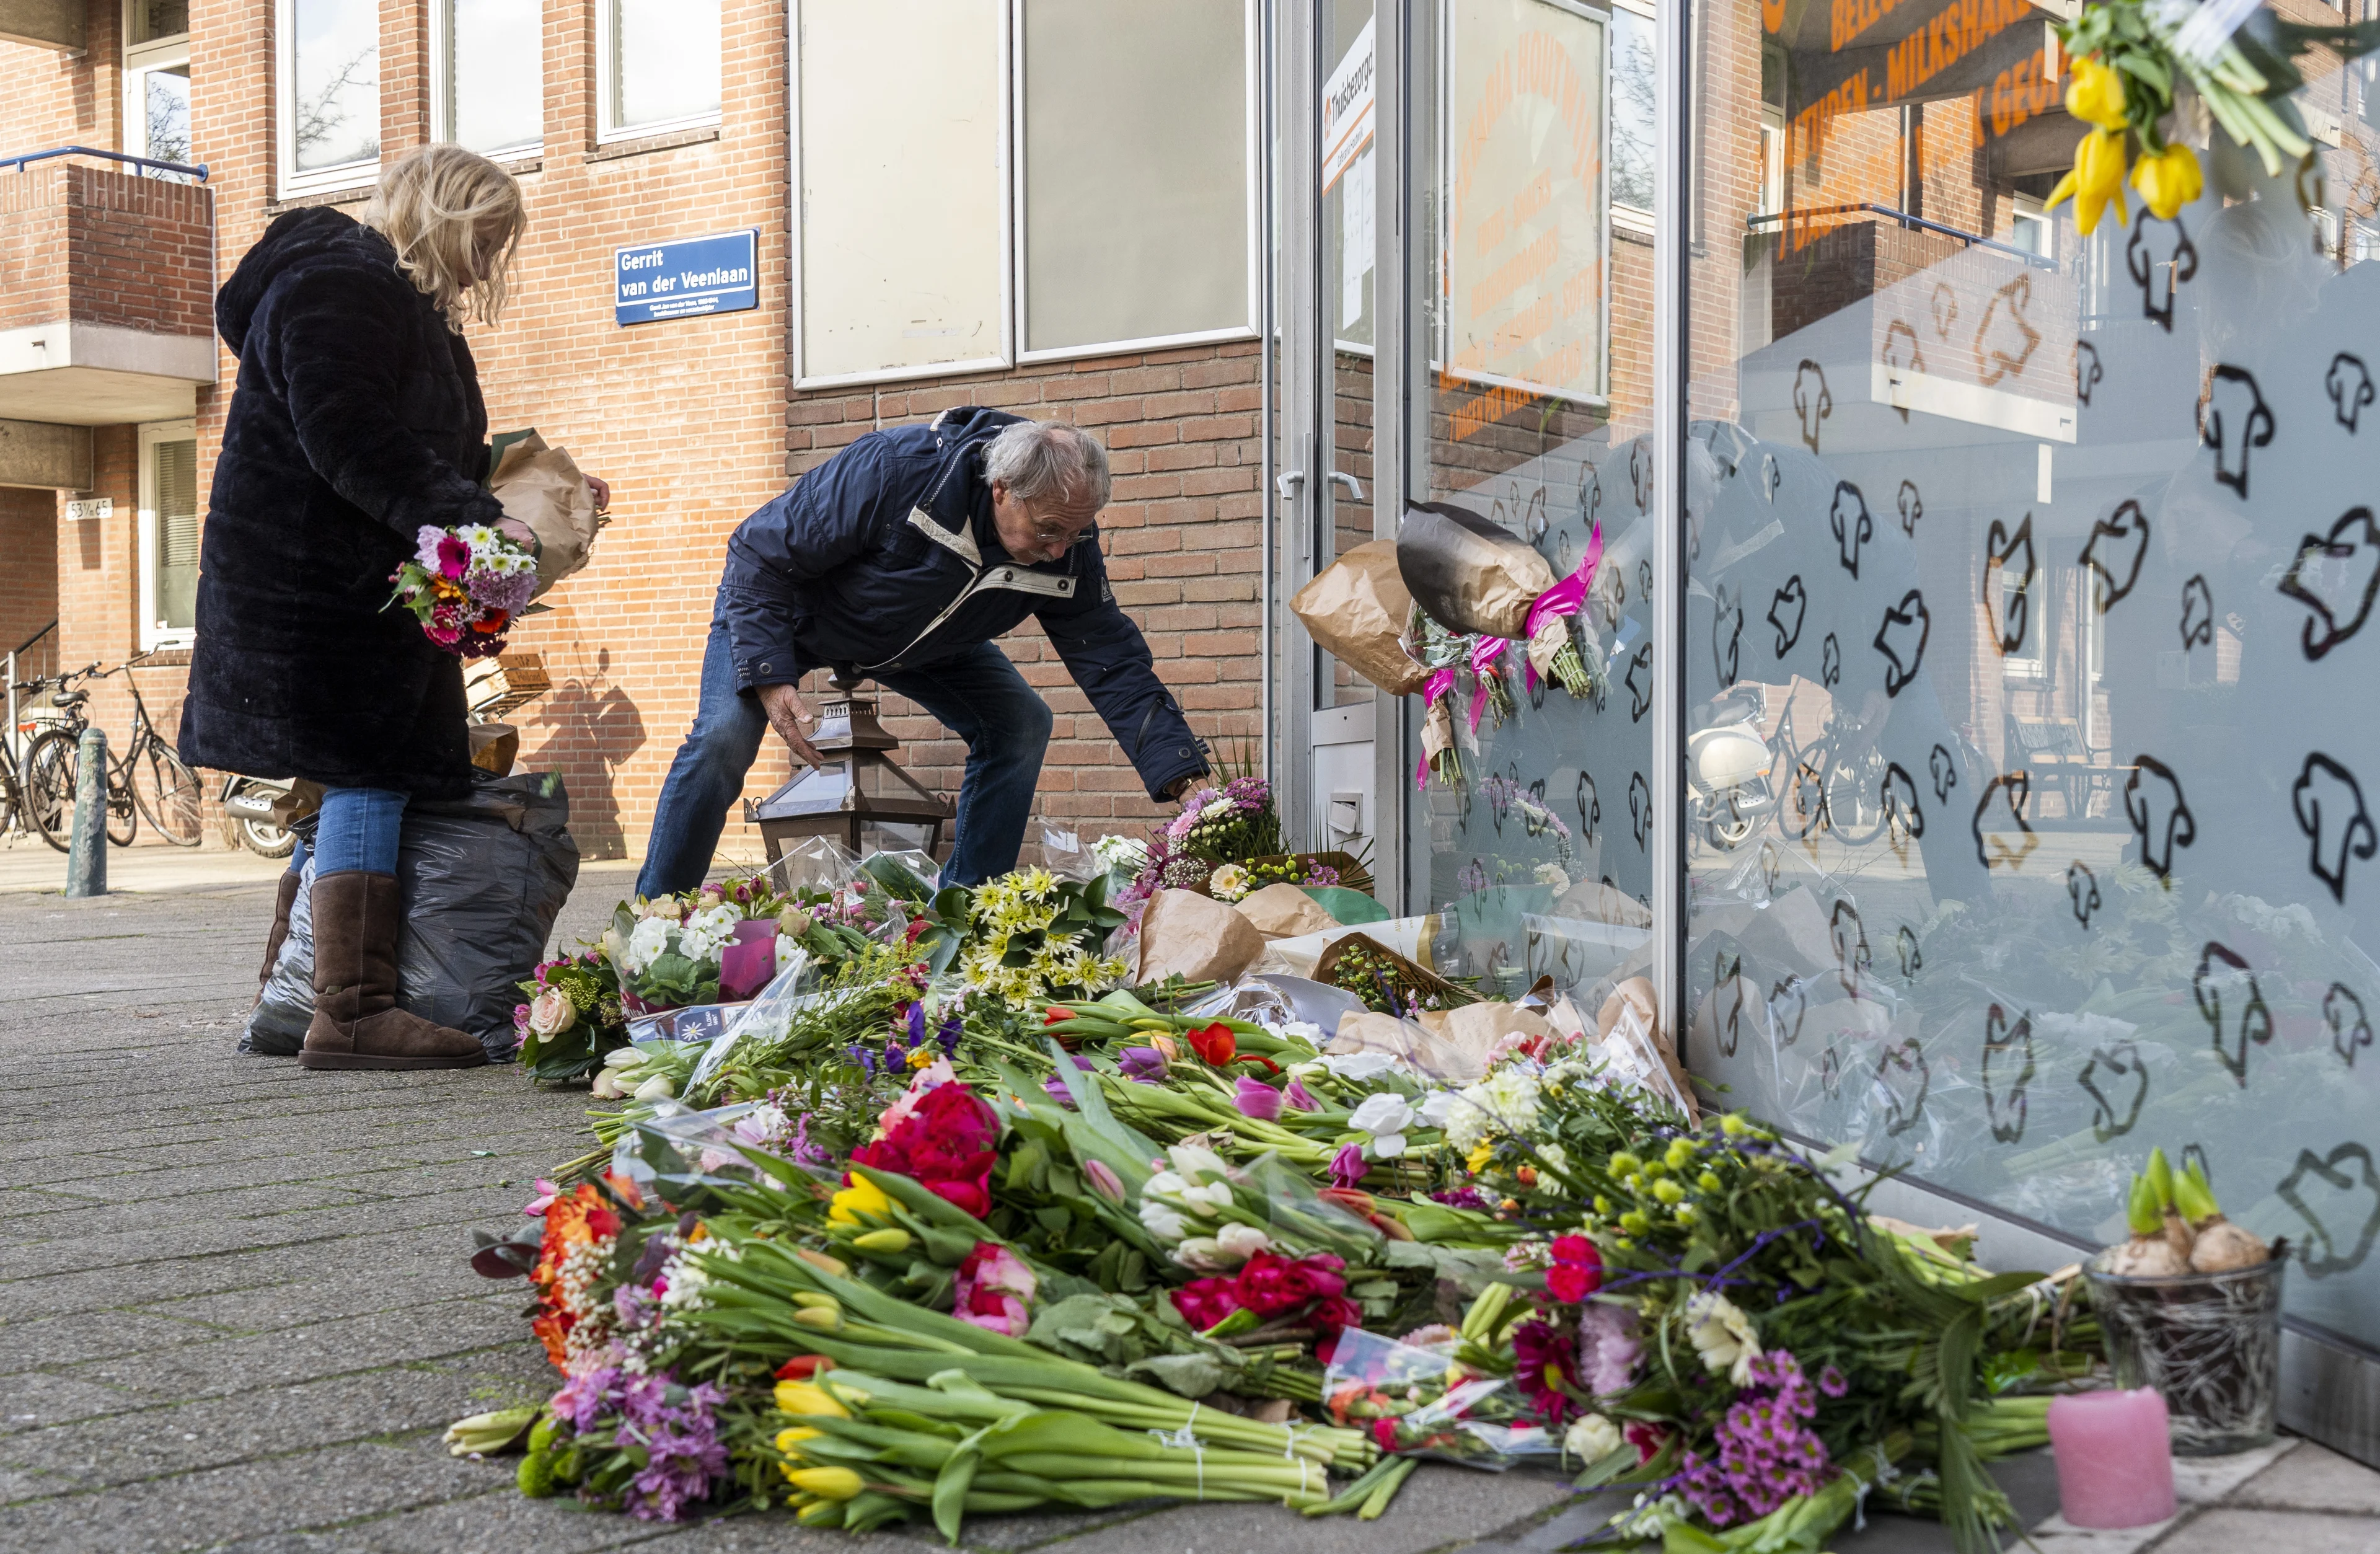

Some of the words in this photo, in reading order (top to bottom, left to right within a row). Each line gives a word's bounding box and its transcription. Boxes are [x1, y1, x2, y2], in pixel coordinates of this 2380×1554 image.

[621, 249, 663, 271] Gerrit
[621, 281, 647, 297] van
[652, 275, 677, 293] der
[681, 267, 747, 289] Veenlaan
[1456, 395, 1483, 441] DAGEN
[1485, 385, 1502, 425] PER
